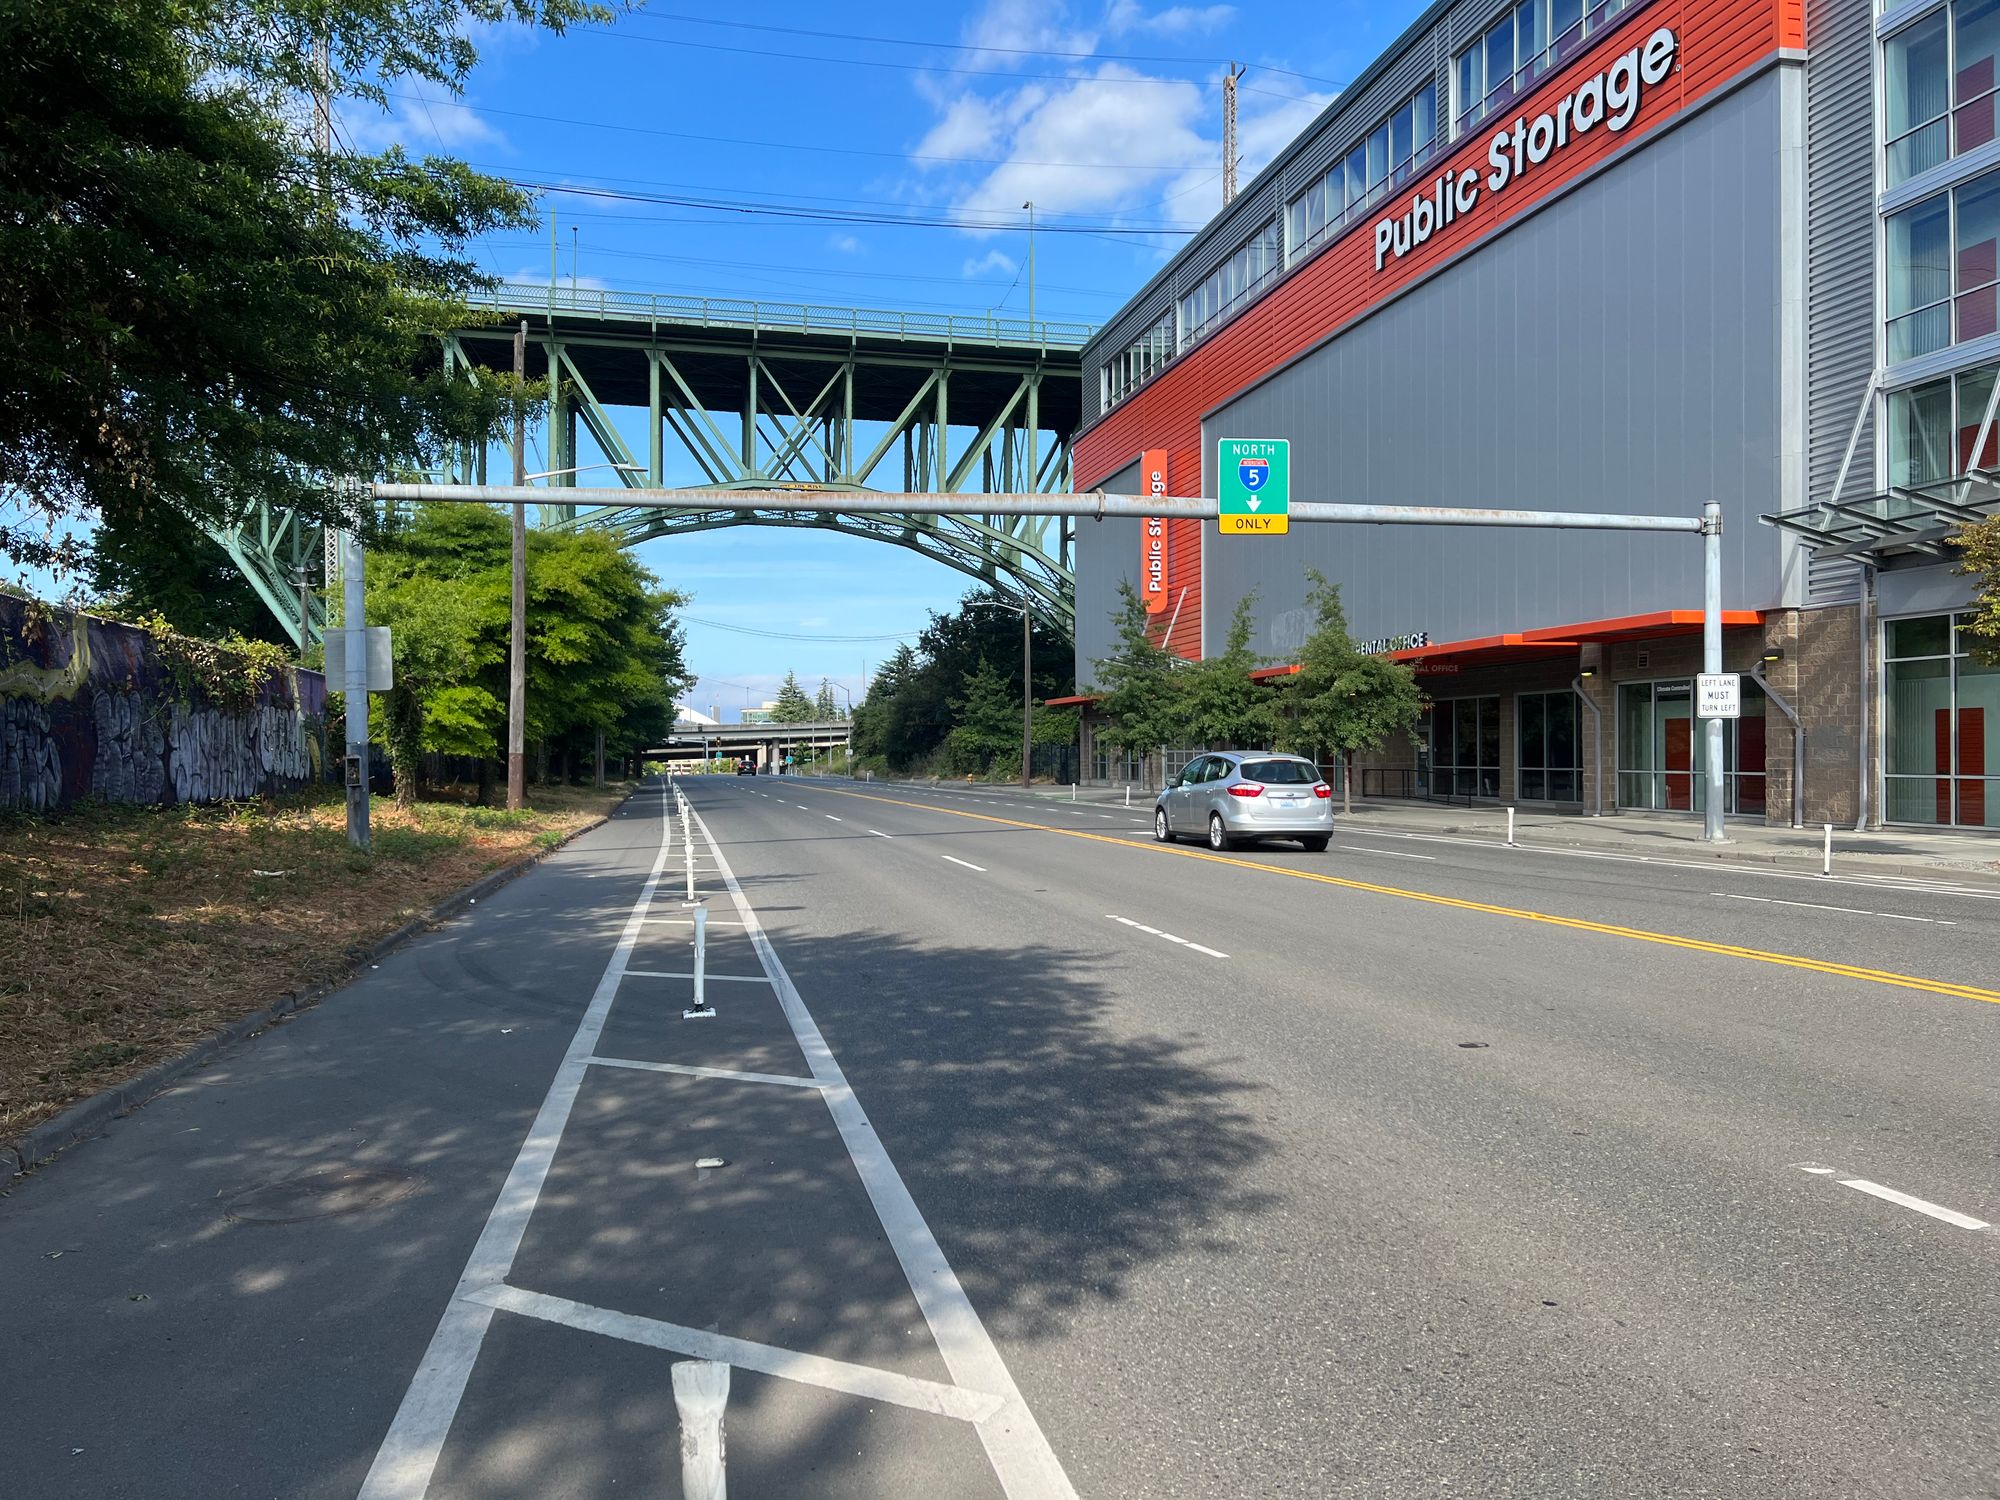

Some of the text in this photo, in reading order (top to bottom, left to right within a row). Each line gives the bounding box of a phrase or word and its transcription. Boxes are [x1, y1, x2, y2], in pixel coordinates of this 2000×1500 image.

[1375, 27, 1676, 272] Public Storage
[1232, 444, 1275, 455] NORTH
[1249, 469, 1260, 486] 5
[1236, 518, 1271, 529] ONLY
[1149, 470, 1165, 592] Public Stge
[1390, 632, 1424, 650] OFFICE
[1431, 664, 1459, 672] OFFICE
[1707, 691, 1729, 700] MUST
